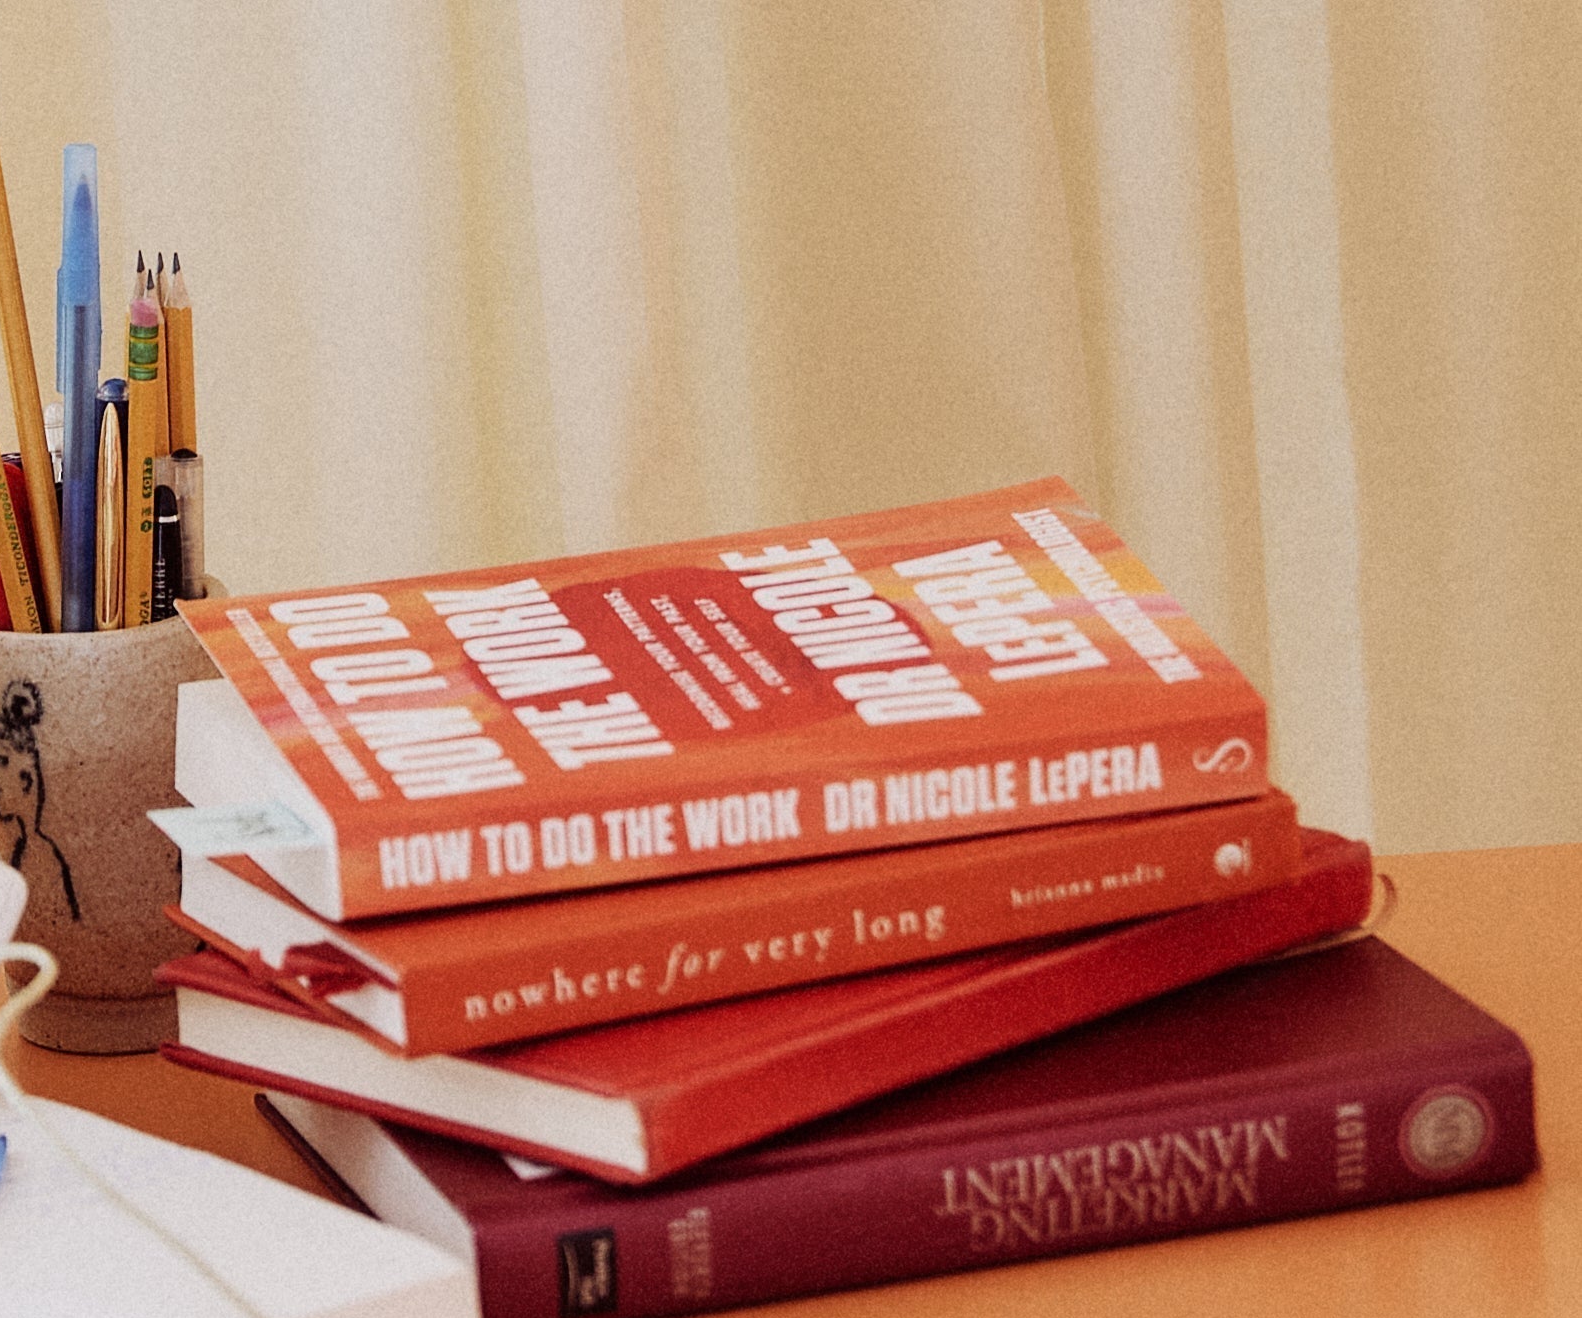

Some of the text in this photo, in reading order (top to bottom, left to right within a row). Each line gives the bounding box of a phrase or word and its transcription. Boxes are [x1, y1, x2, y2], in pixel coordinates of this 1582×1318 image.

[24, 595, 42, 633] IXON
[675, 626, 708, 654] YOUR
[696, 600, 727, 622] SELF
[717, 623, 750, 652] YOUR
[721, 539, 983, 726] DR NICOLE
[270, 594, 525, 800] HOW TO DO
[424, 579, 675, 771] THE WORK
[379, 788, 801, 889] HOW TO DO THE WORK
[824, 779, 878, 833] DR
[885, 761, 1017, 825] NICOLE
[1011, 879, 1095, 908] brianna
[463, 905, 946, 1021] nowhere for very long
[935, 1115, 1288, 1217] MANAGEMENT
[968, 1168, 1257, 1252] MARKETING
